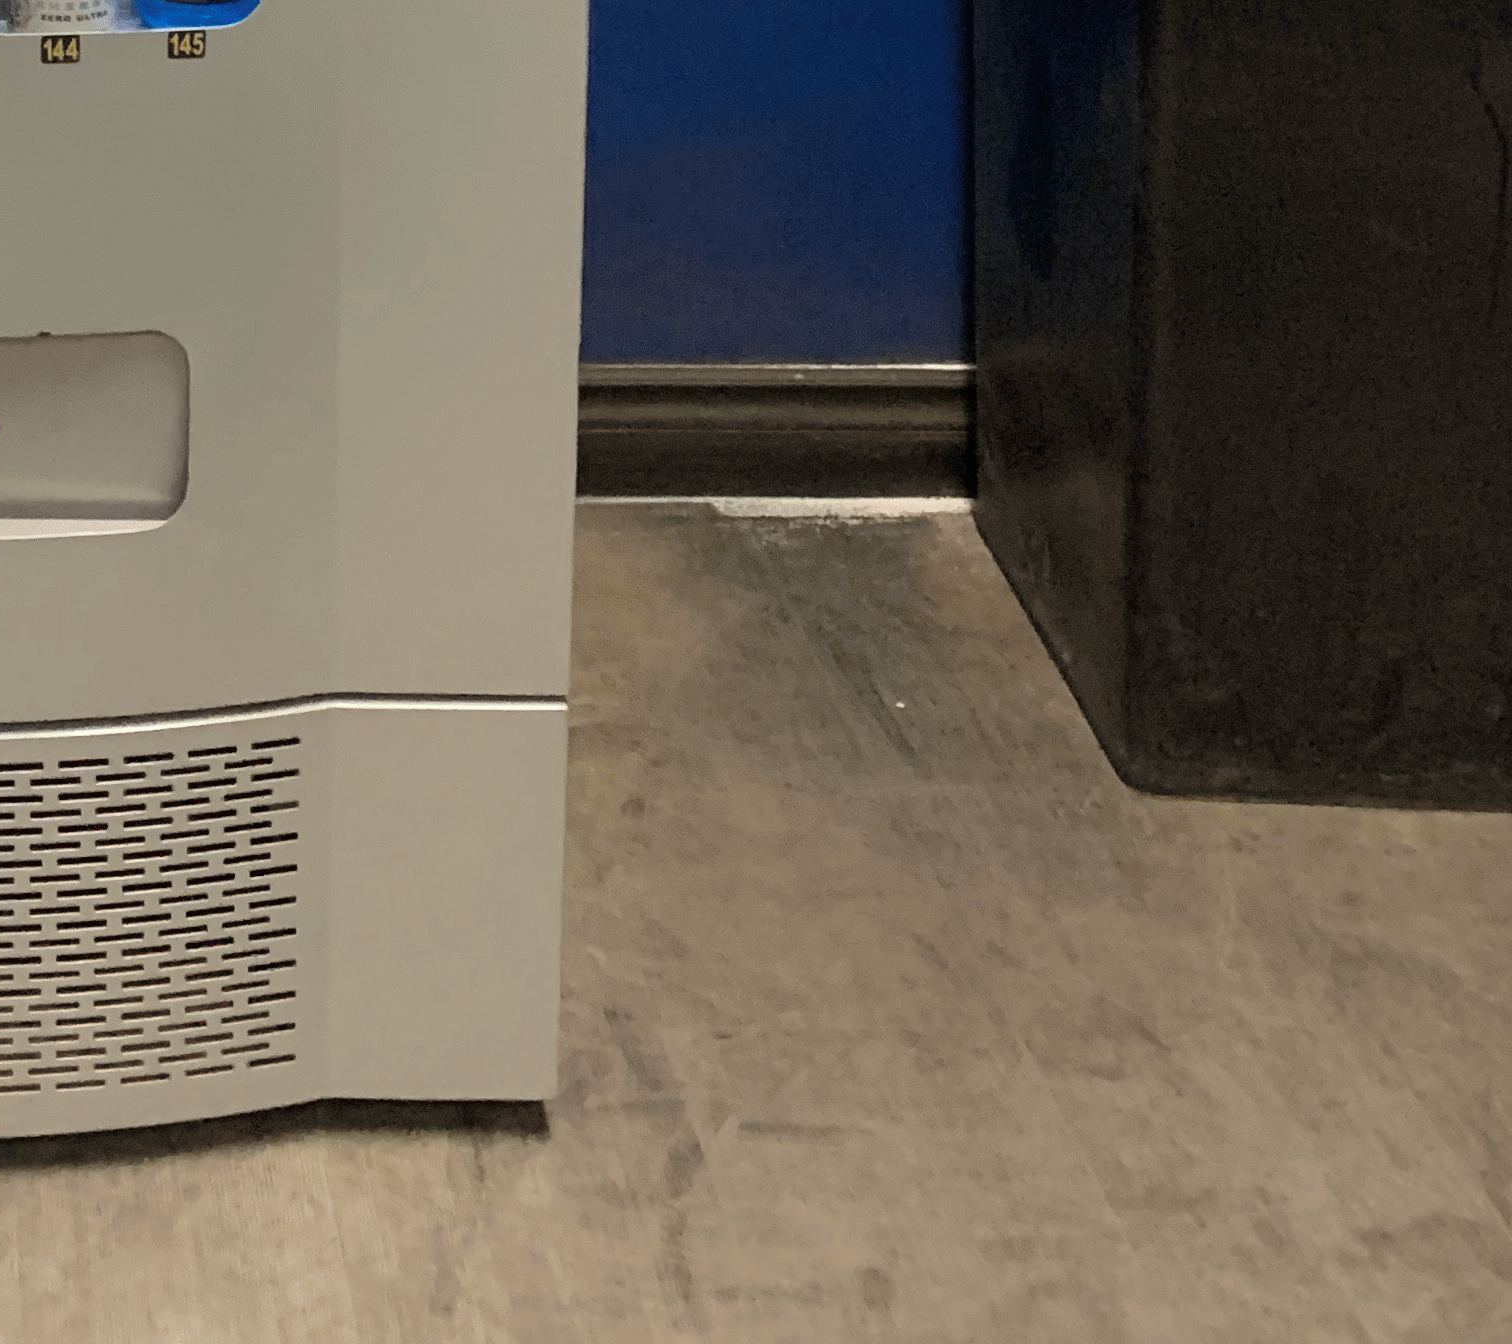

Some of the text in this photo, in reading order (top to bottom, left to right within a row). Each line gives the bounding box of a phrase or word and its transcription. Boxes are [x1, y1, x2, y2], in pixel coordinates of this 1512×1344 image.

[41, 13, 72, 23] ZERO
[44, 38, 78, 61] 144
[170, 33, 205, 56] 145
